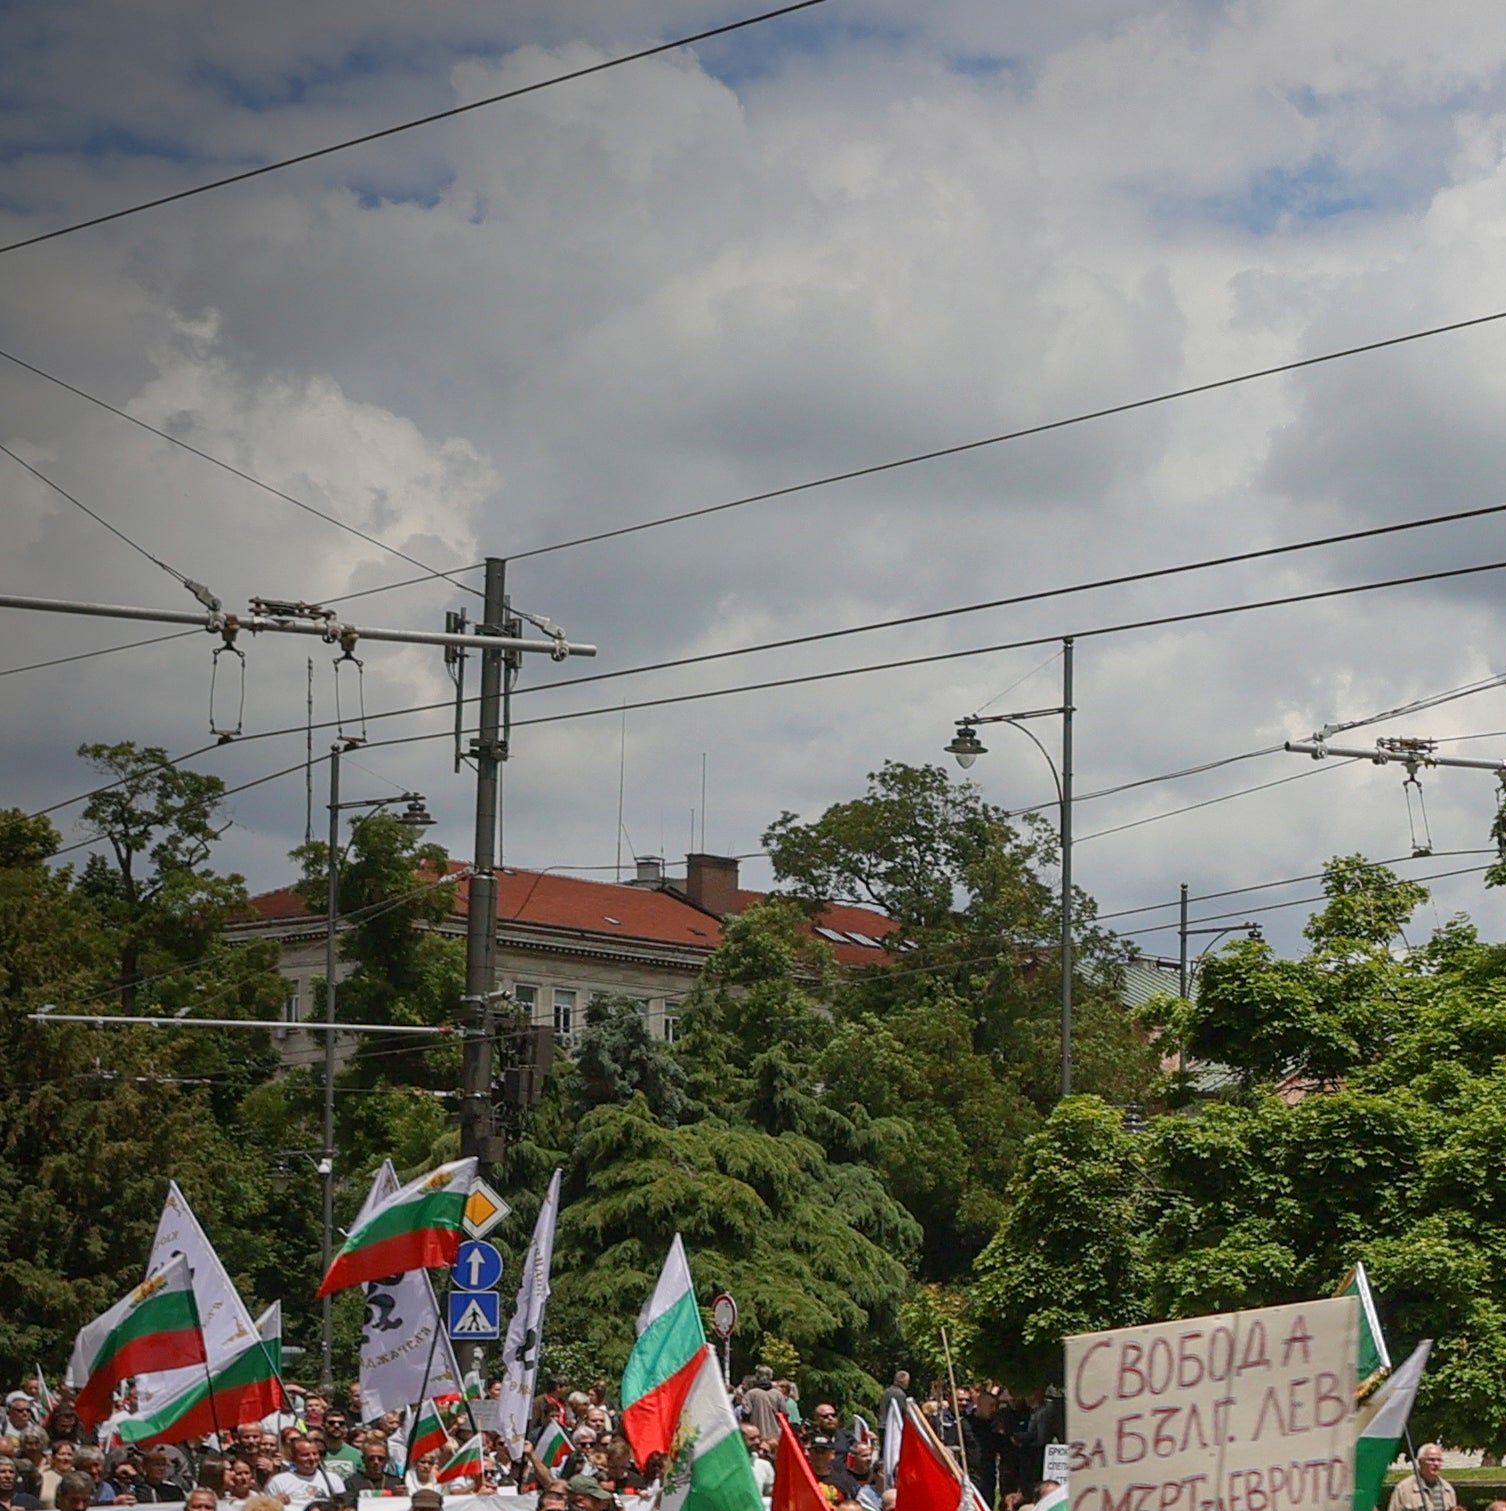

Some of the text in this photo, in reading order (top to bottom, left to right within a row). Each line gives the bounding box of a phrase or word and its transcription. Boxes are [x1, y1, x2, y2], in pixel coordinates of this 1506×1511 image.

[1075, 1315, 1313, 1411] СВОБОДА
[1070, 1440, 1106, 1471] ЗА
[1116, 1397, 1236, 1464] БЪЛГ.
